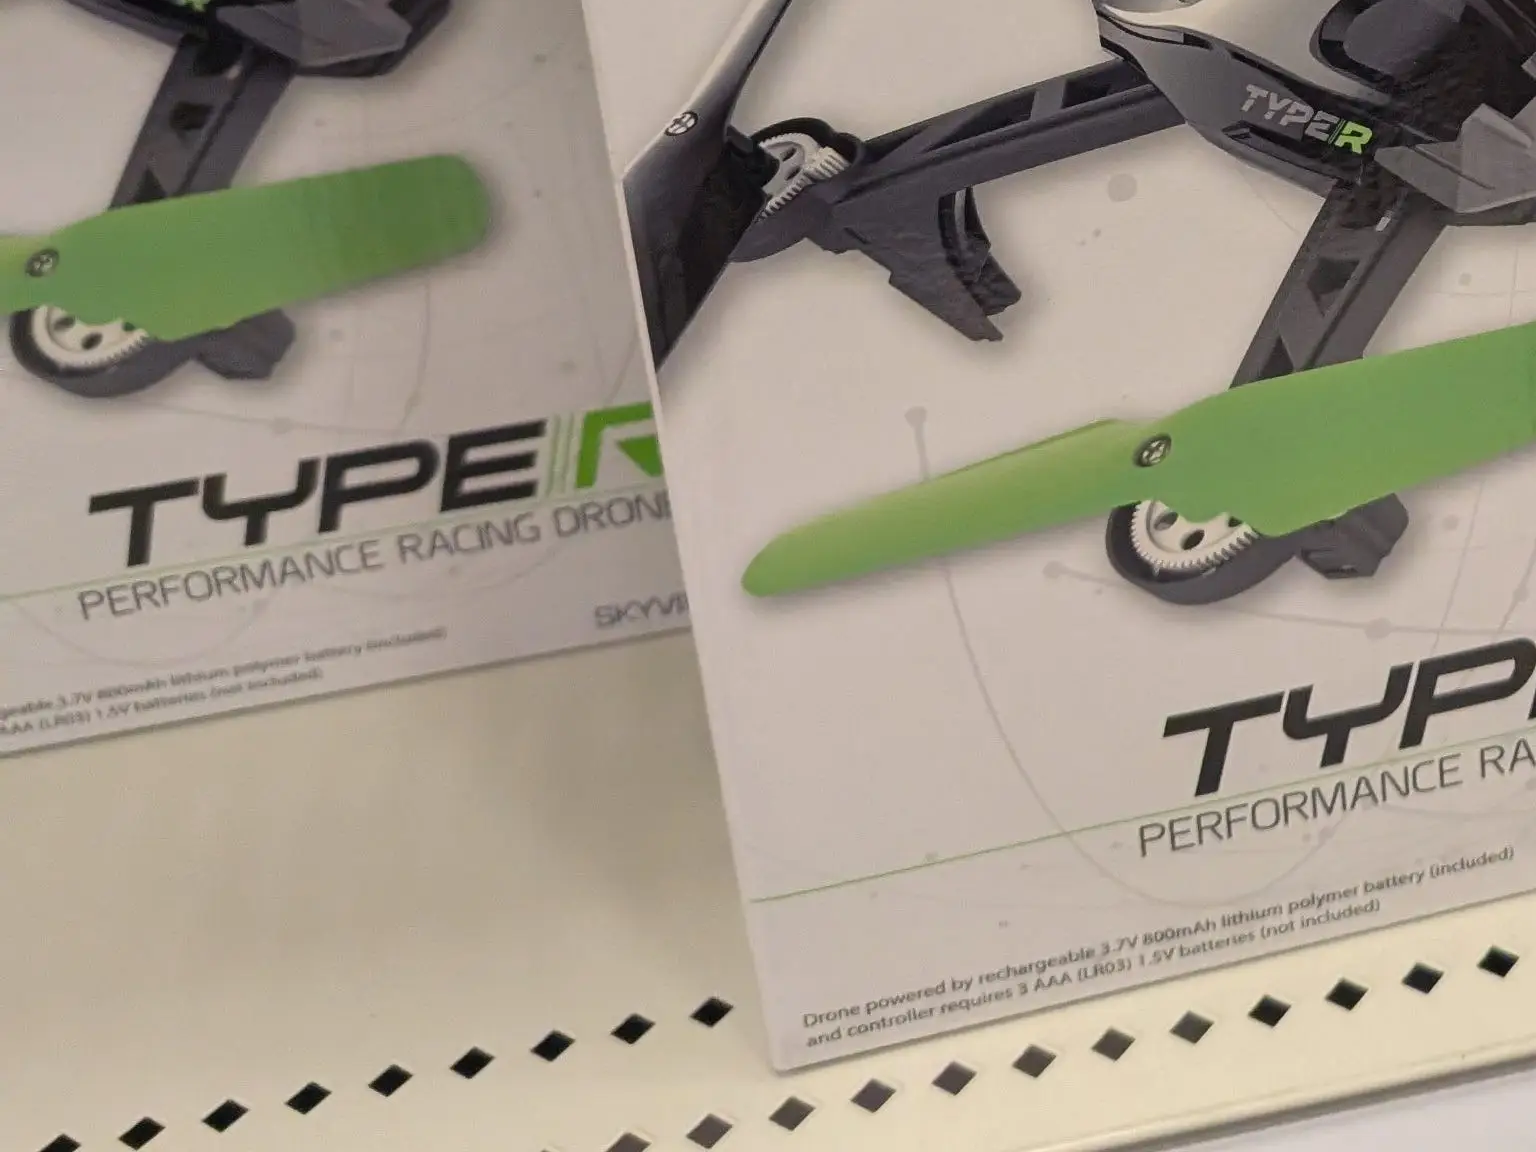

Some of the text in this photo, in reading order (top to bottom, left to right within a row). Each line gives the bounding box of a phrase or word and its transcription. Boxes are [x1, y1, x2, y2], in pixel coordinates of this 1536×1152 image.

[78, 490, 674, 622] PERFORMANCE RACING DRON
[1138, 754, 1463, 857] PERFORMANCE
[803, 846, 1516, 1030] Drone powered by rechargeable 3.7V 800mAh lithium polymer battery (included)
[806, 897, 1382, 1049] and controller requires 3 AAA (LR03) 1.5V batteries (not included)
